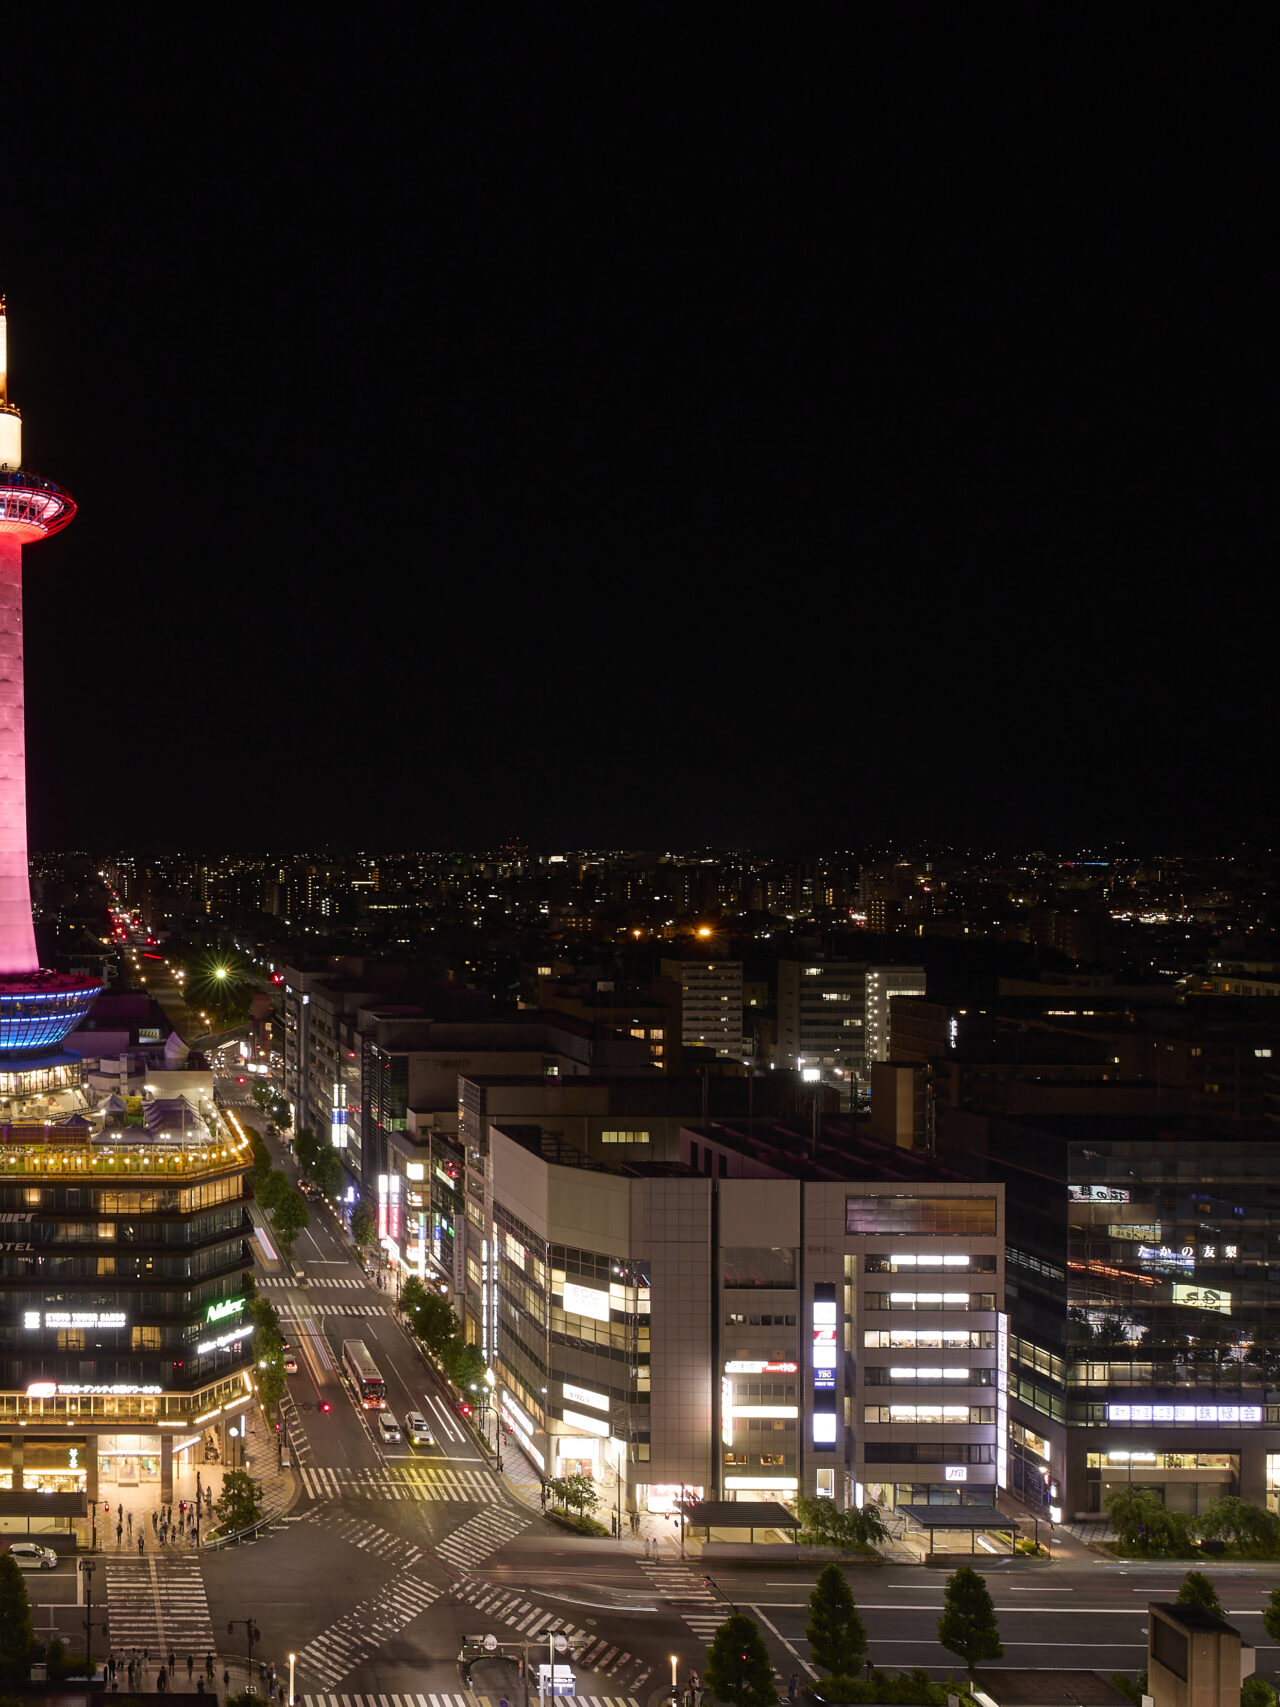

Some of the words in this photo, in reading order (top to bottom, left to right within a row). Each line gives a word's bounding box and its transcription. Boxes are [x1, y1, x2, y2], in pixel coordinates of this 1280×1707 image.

[1137, 1245, 1238, 1258] たかの友梨
[207, 1298, 246, 1323] Nidec
